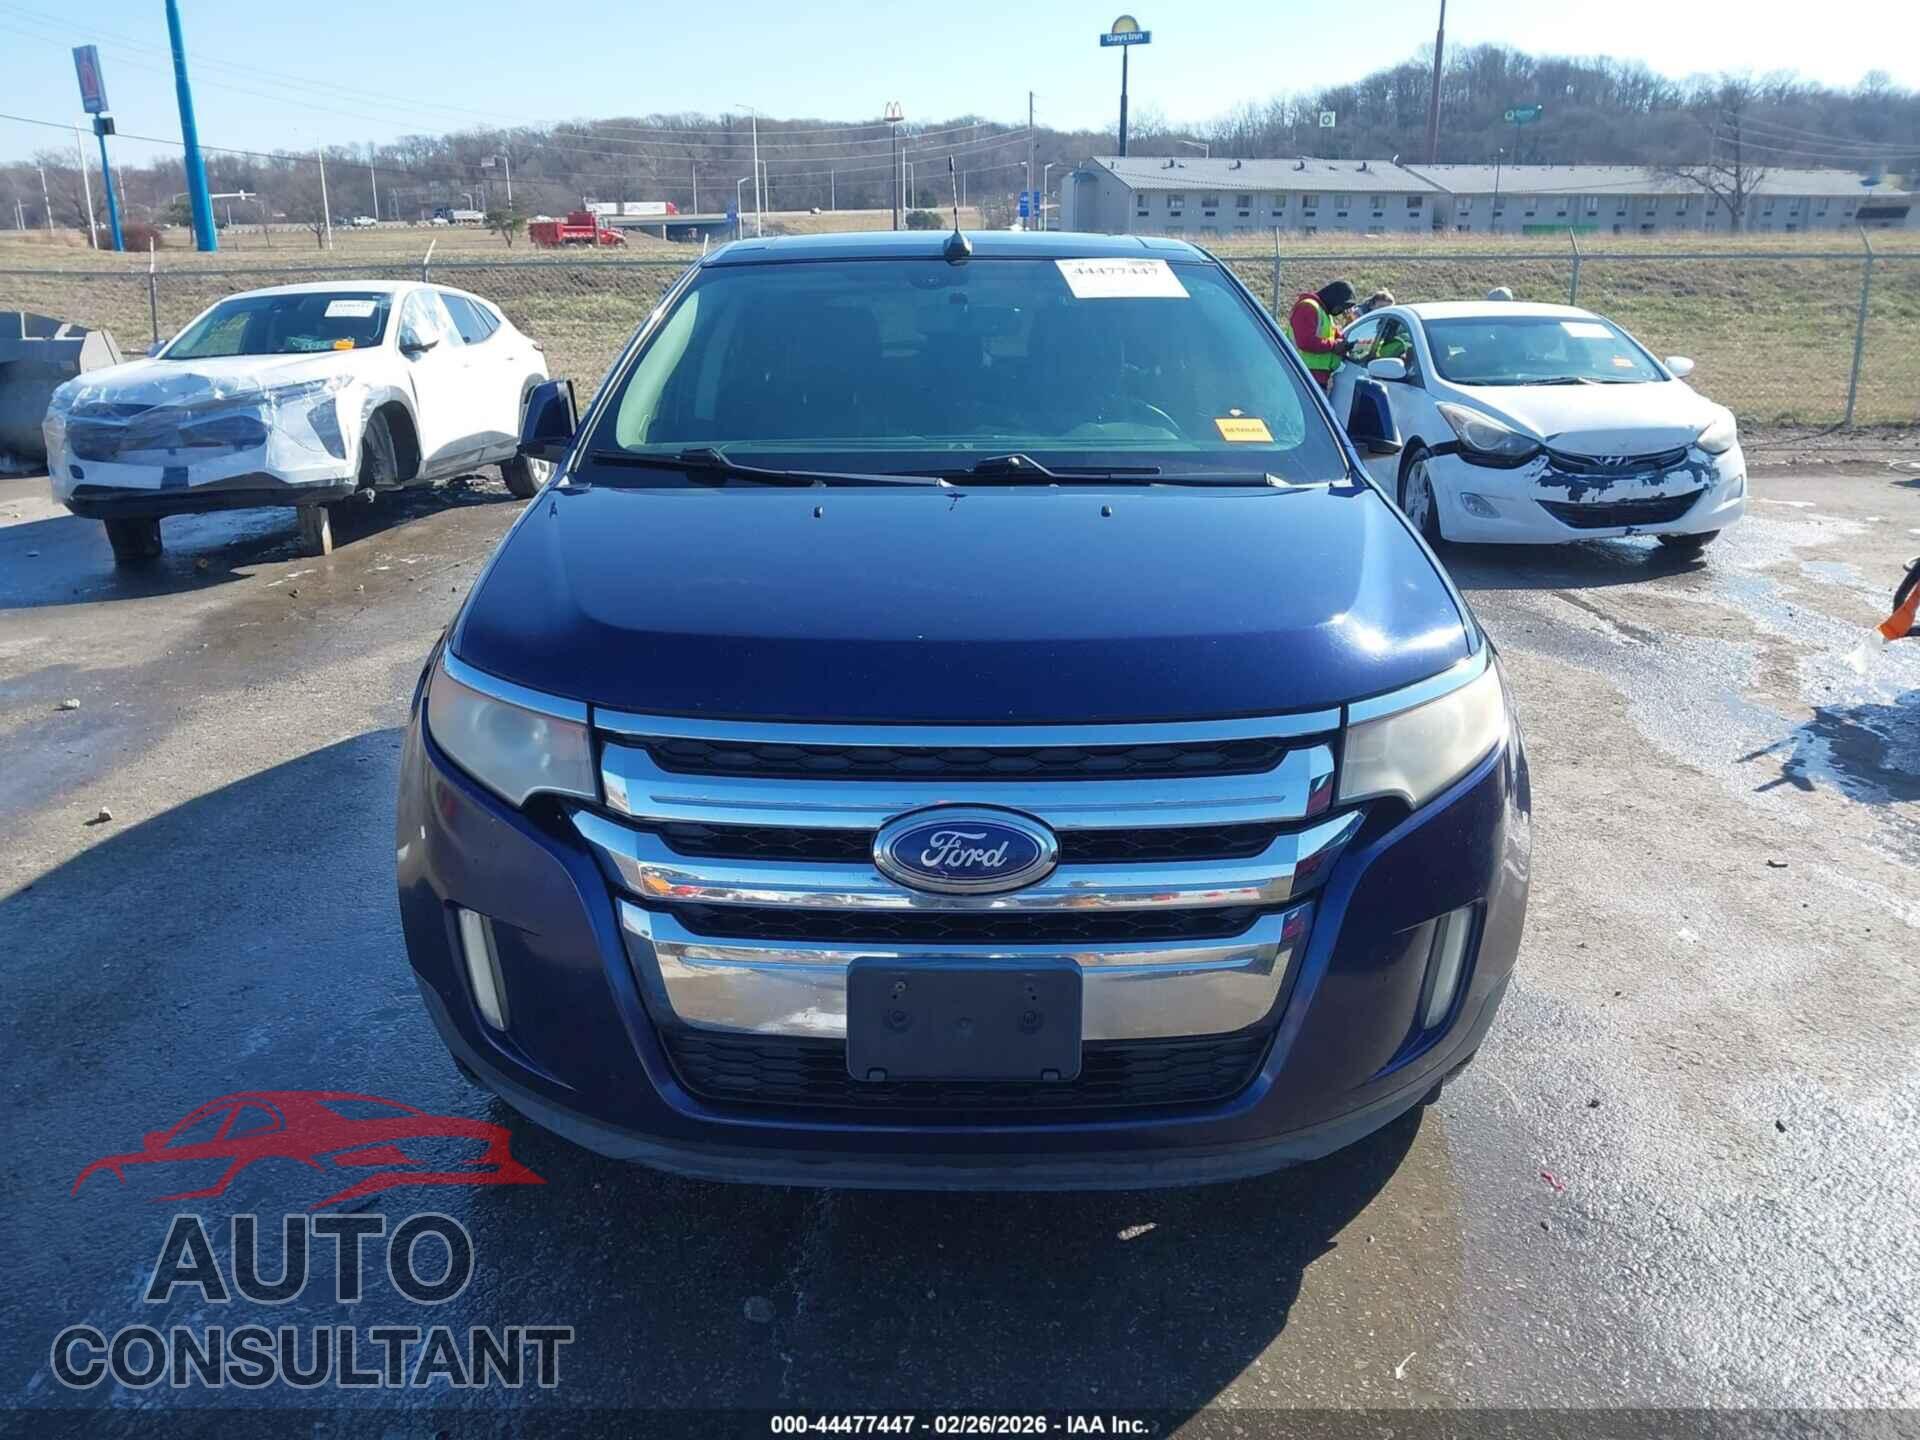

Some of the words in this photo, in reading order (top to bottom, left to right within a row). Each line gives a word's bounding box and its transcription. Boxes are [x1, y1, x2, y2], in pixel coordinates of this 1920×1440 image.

[1106, 34, 1127, 43] Days
[1128, 32, 1143, 41] Inn
[1072, 266, 1158, 277] 44477447
[920, 830, 1008, 867] Ford
